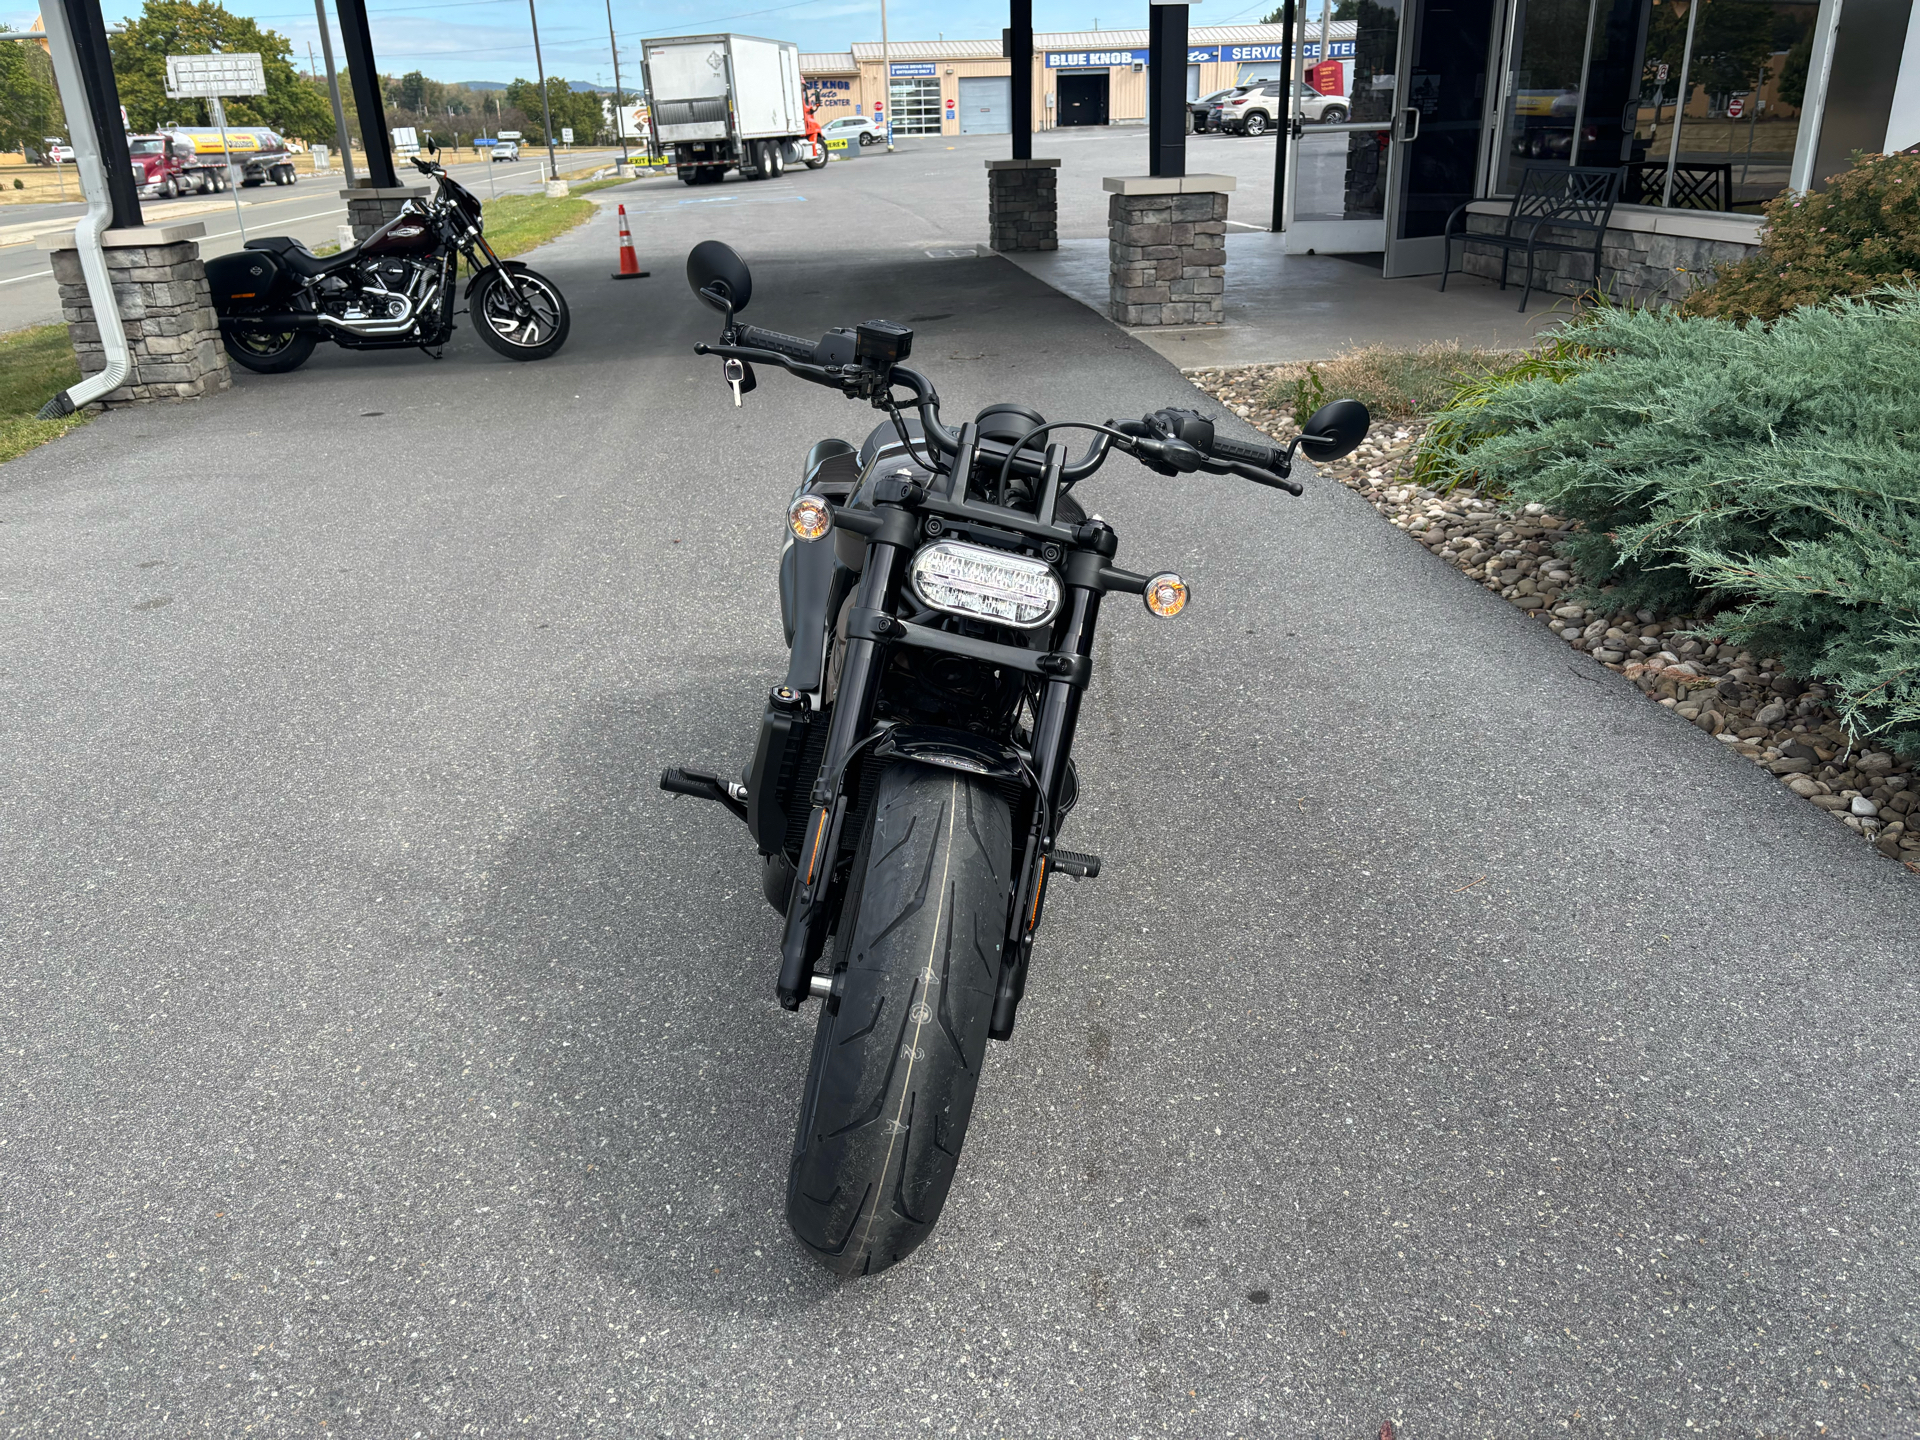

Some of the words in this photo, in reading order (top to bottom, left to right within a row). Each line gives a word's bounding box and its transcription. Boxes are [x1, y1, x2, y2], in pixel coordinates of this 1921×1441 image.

[1303, 43, 1356, 56] CETER
[1049, 54, 1087, 66] BLUE
[1089, 52, 1133, 65] KNOB
[822, 81, 850, 90] KNOB
[824, 99, 851, 107] CENTER
